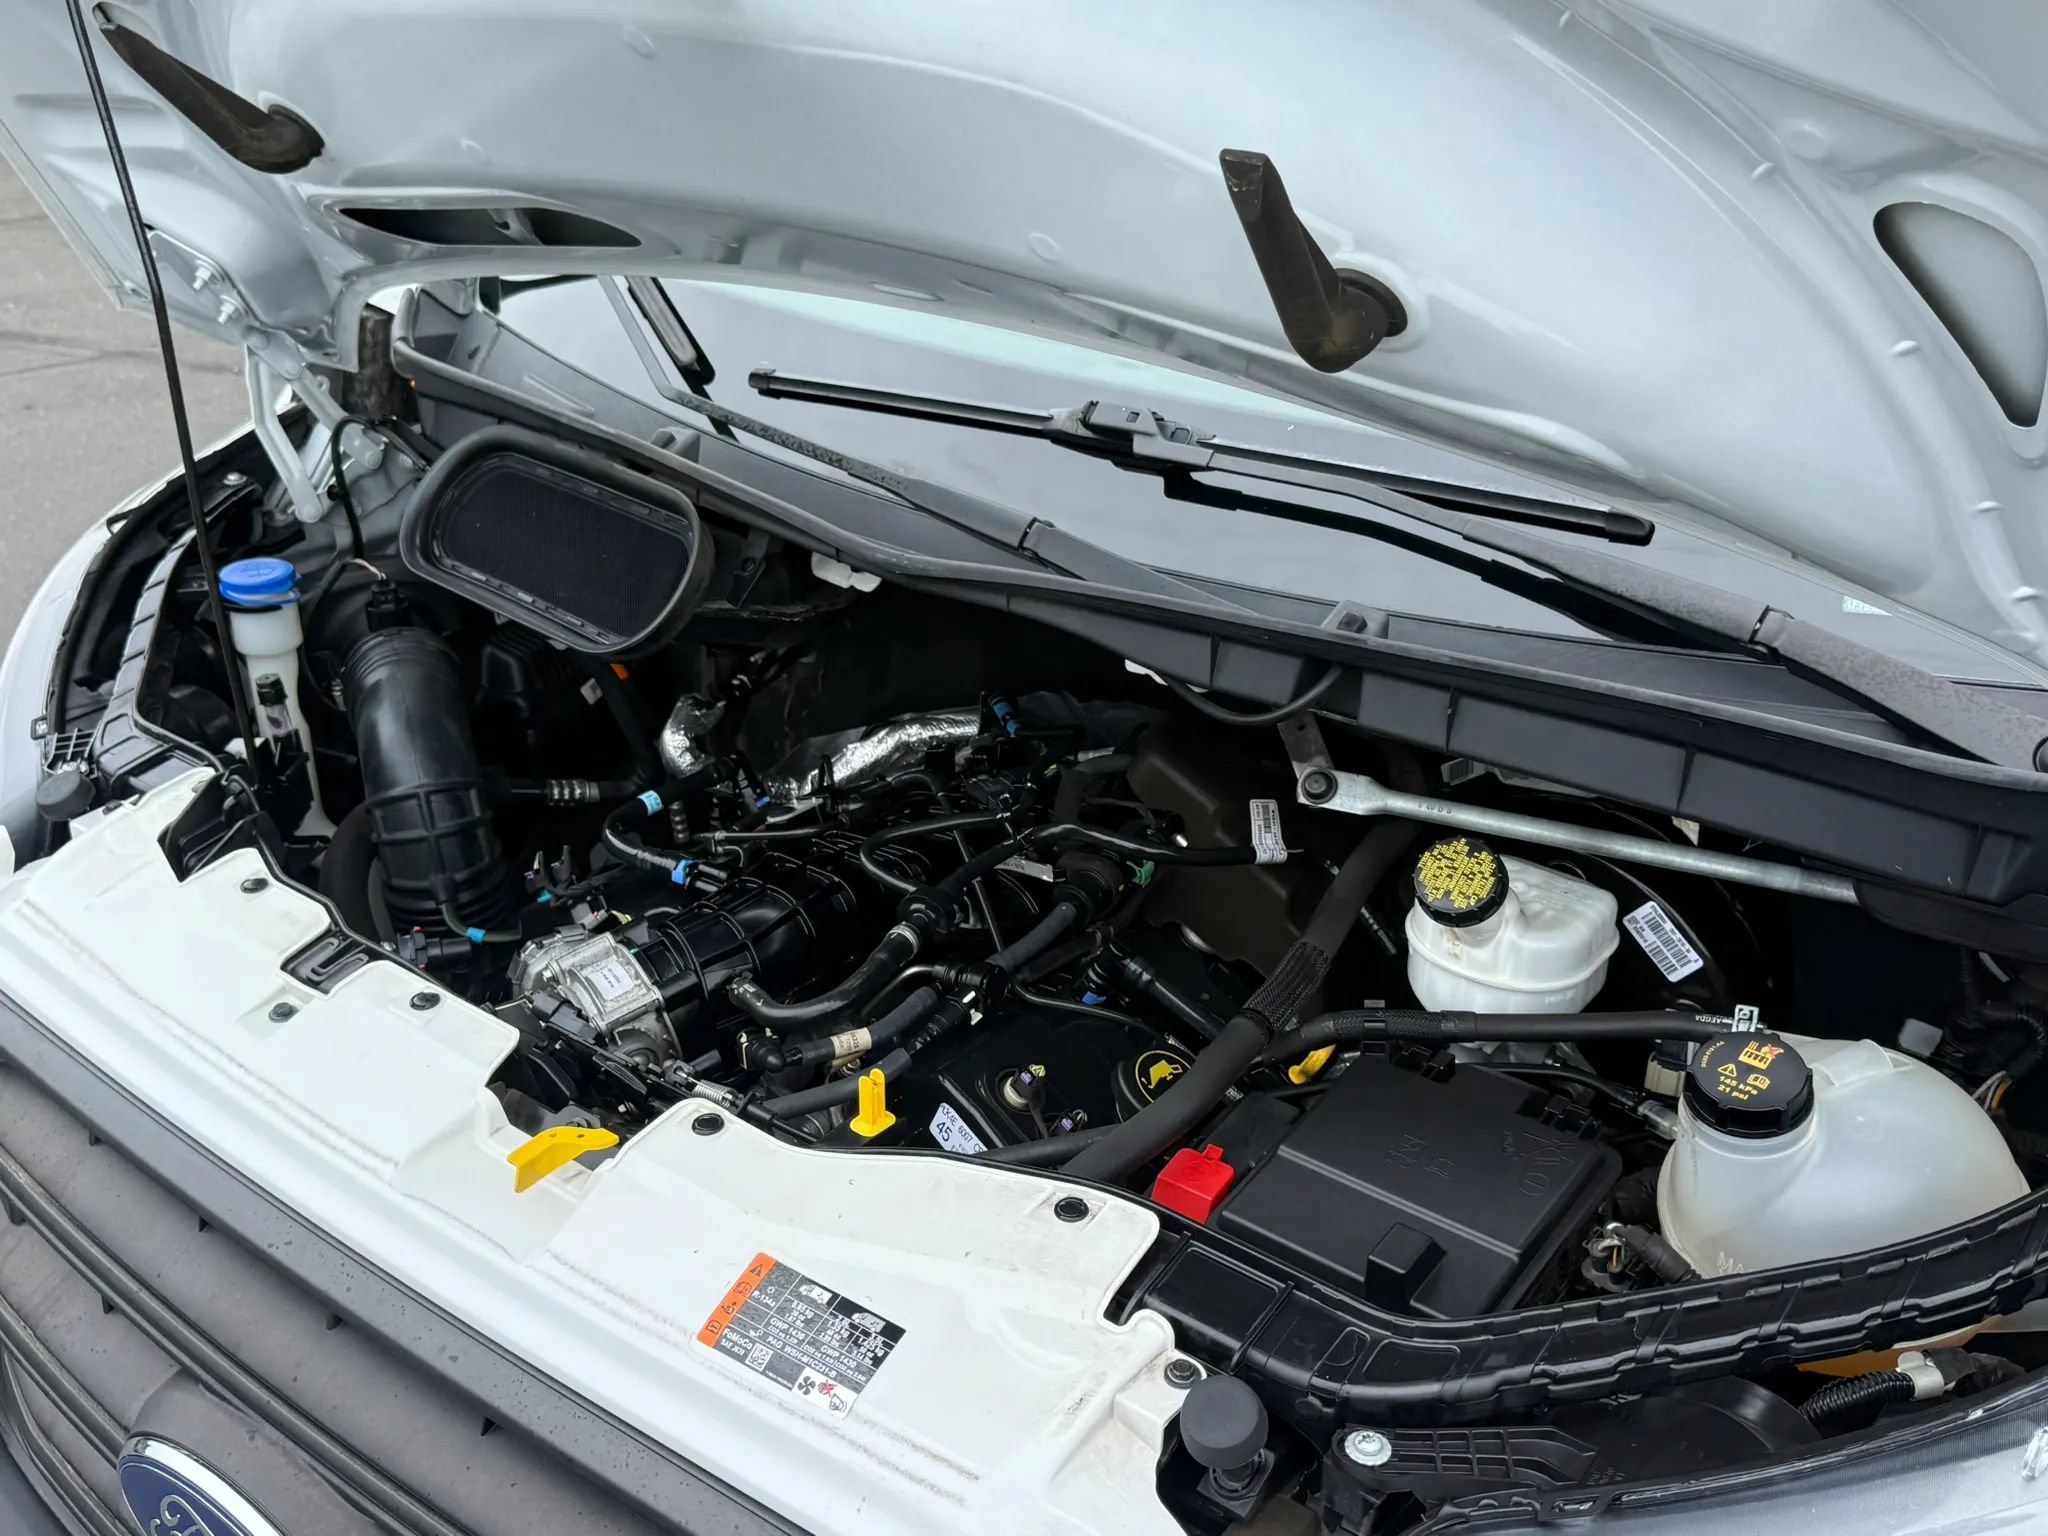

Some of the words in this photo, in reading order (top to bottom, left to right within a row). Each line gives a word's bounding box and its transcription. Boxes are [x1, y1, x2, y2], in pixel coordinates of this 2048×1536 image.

[1717, 1084, 1731, 1093] 21
[1731, 1091, 1749, 1100] psi
[1719, 1076, 1738, 1087] 145
[1738, 1083, 1758, 1095] kPa
[936, 1122, 953, 1142] 45
[958, 1126, 973, 1143] 6007
[751, 1289, 776, 1307] R-134a
[769, 1316, 789, 1331] GWP
[787, 1326, 806, 1340] 1430
[721, 1327, 754, 1349] FoMoCo
[819, 1344, 840, 1358] GWP
[838, 1354, 858, 1368] 1430
